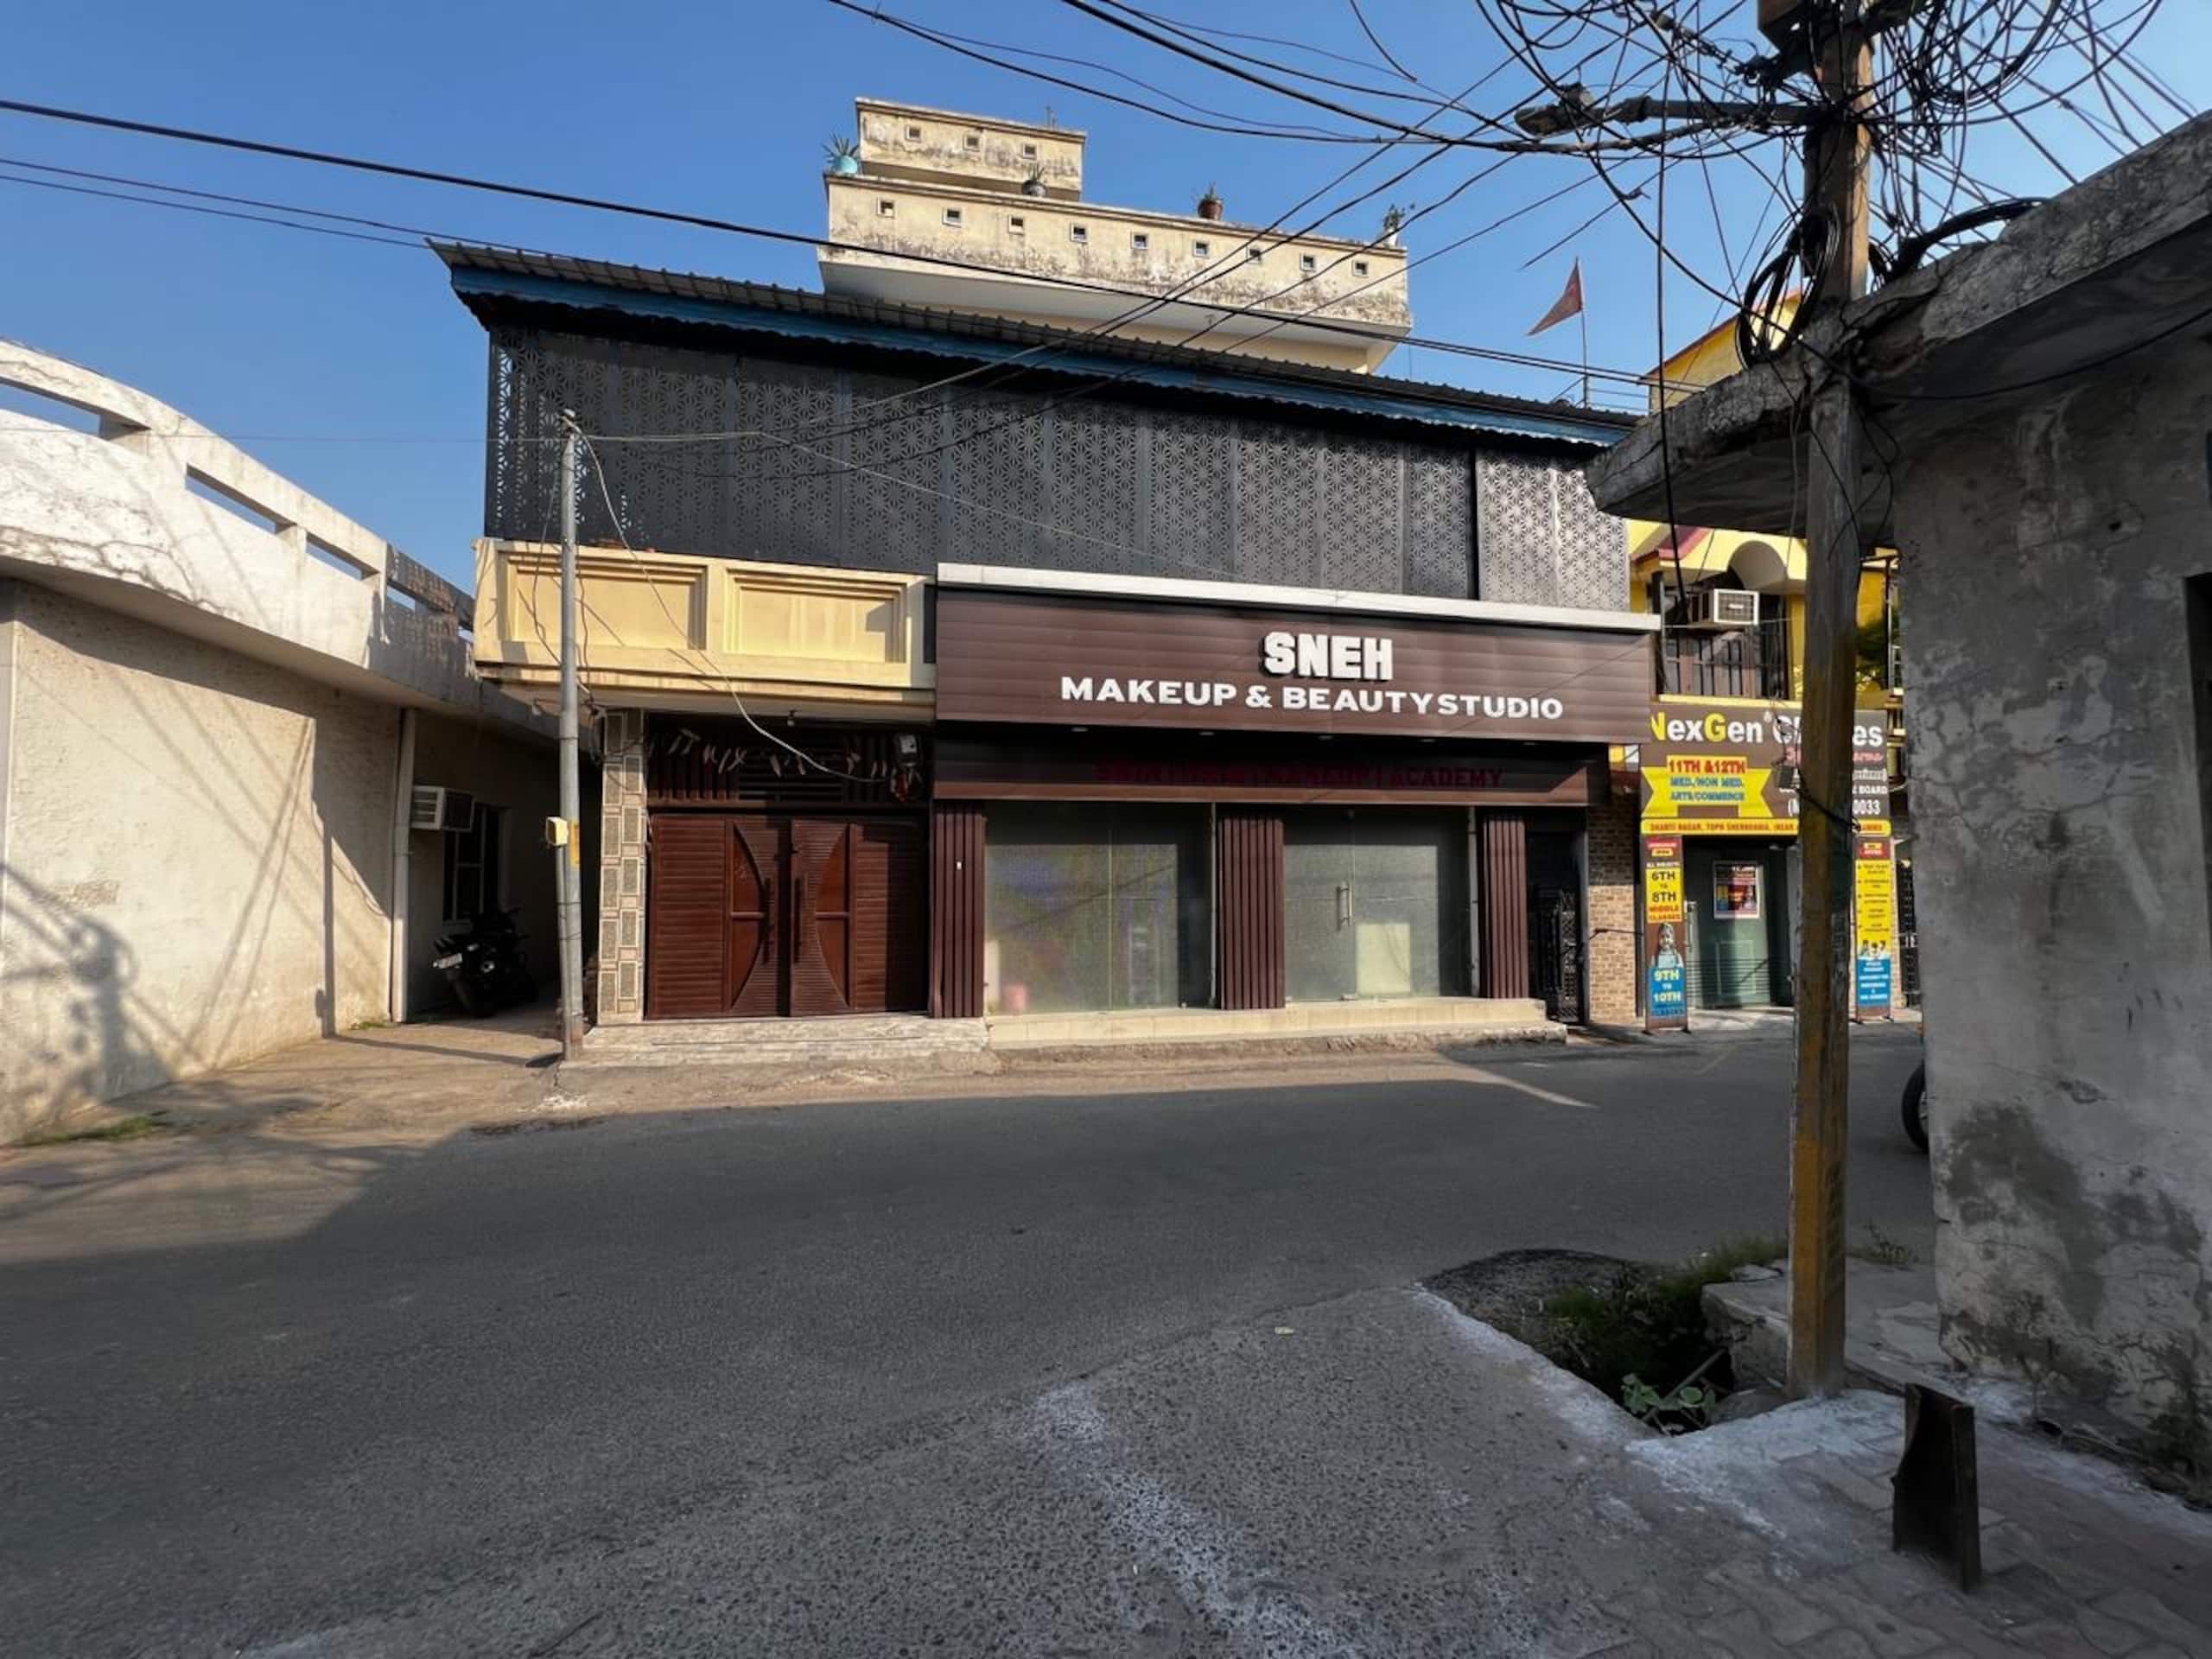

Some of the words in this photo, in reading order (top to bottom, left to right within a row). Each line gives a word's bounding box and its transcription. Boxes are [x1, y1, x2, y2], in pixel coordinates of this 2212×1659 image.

[1262, 631, 1394, 681] SNEH
[1060, 676, 1236, 706] MAKEUP
[1244, 684, 1273, 709] &
[1392, 766, 1505, 788] ACADEMY
[1669, 760, 1700, 774] 11TH
[1651, 871, 1675, 881] 6TH
